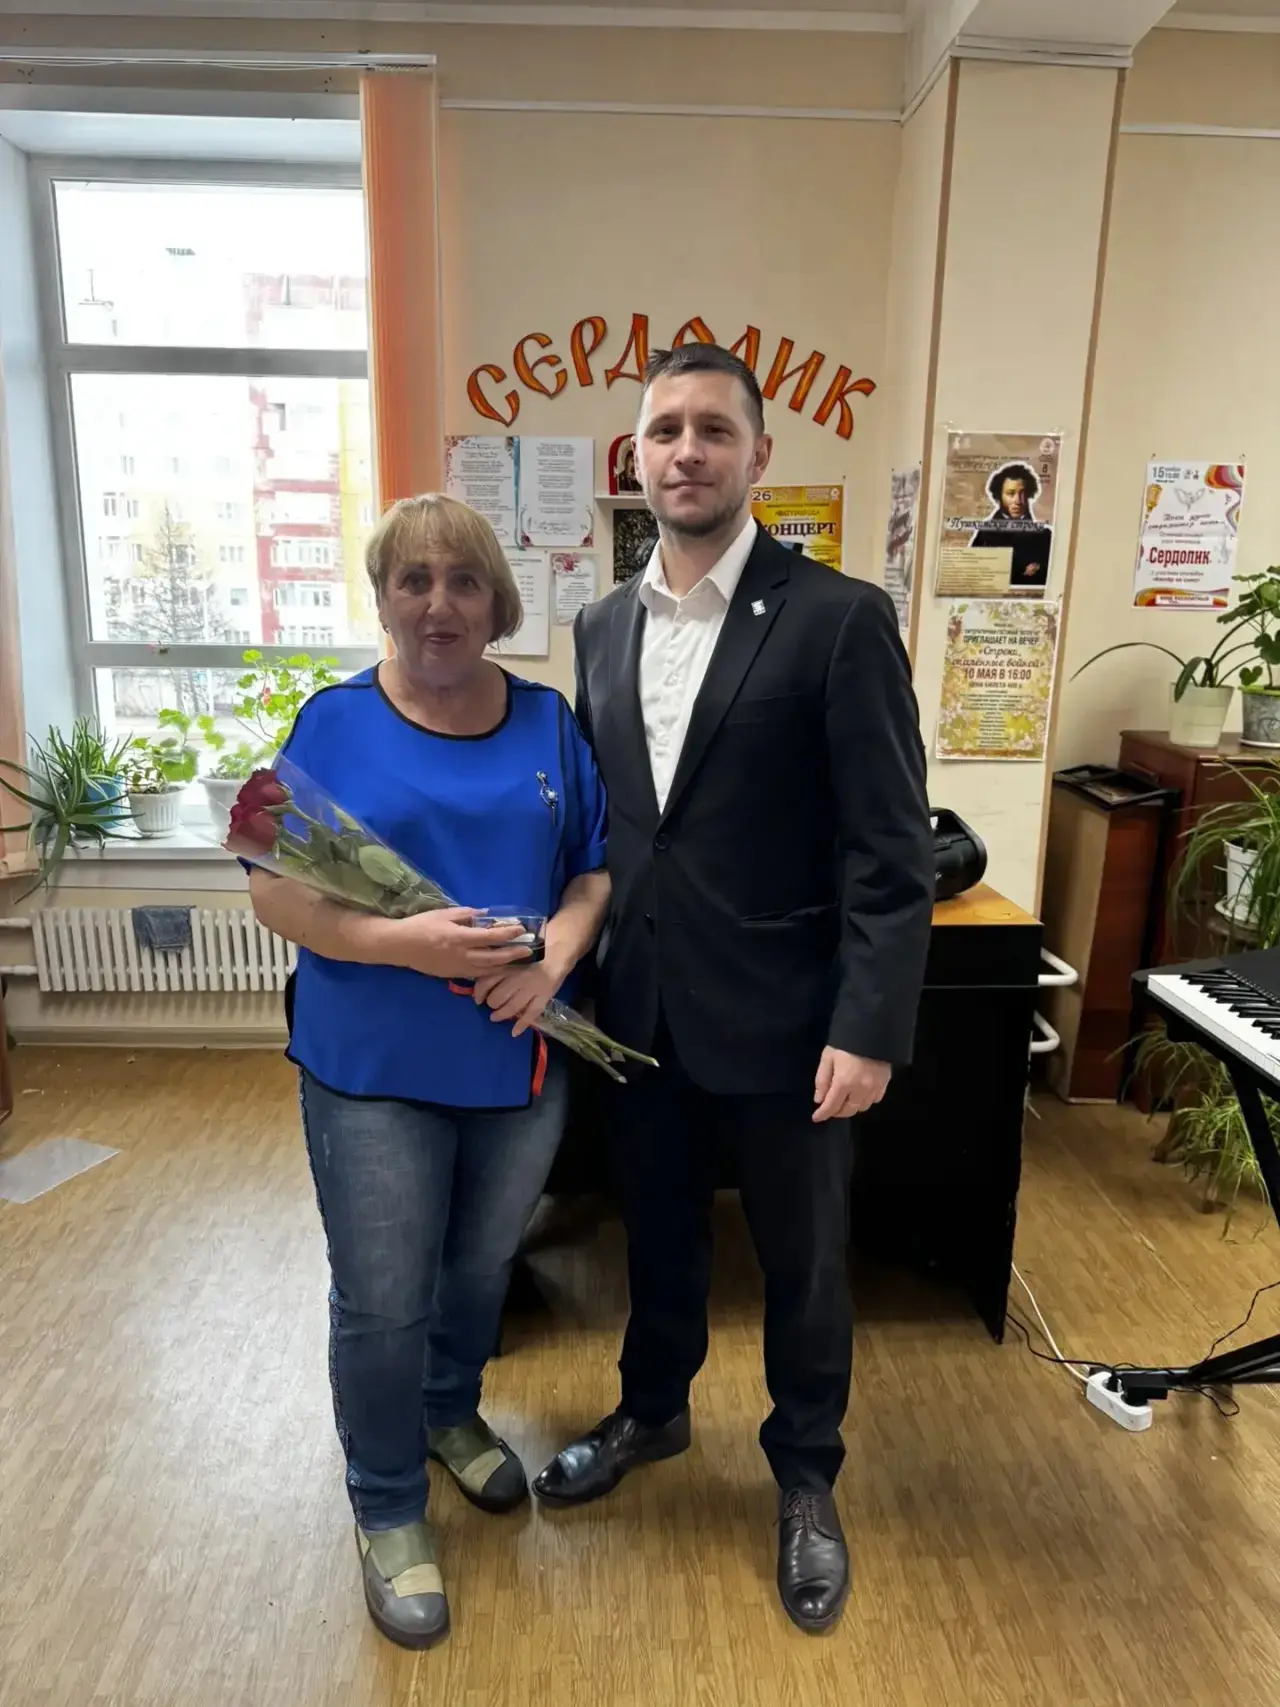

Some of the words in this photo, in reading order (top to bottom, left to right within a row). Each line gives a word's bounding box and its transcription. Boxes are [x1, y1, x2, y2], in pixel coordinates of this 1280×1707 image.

[1152, 466, 1166, 479] 15
[752, 490, 772, 501] 26
[764, 522, 837, 537] ОНЦЕРТ
[1008, 636, 1017, 645] НА
[1019, 636, 1039, 645] ВЕЧЕР
[964, 668, 975, 679] 10
[976, 668, 997, 679] МАЯ
